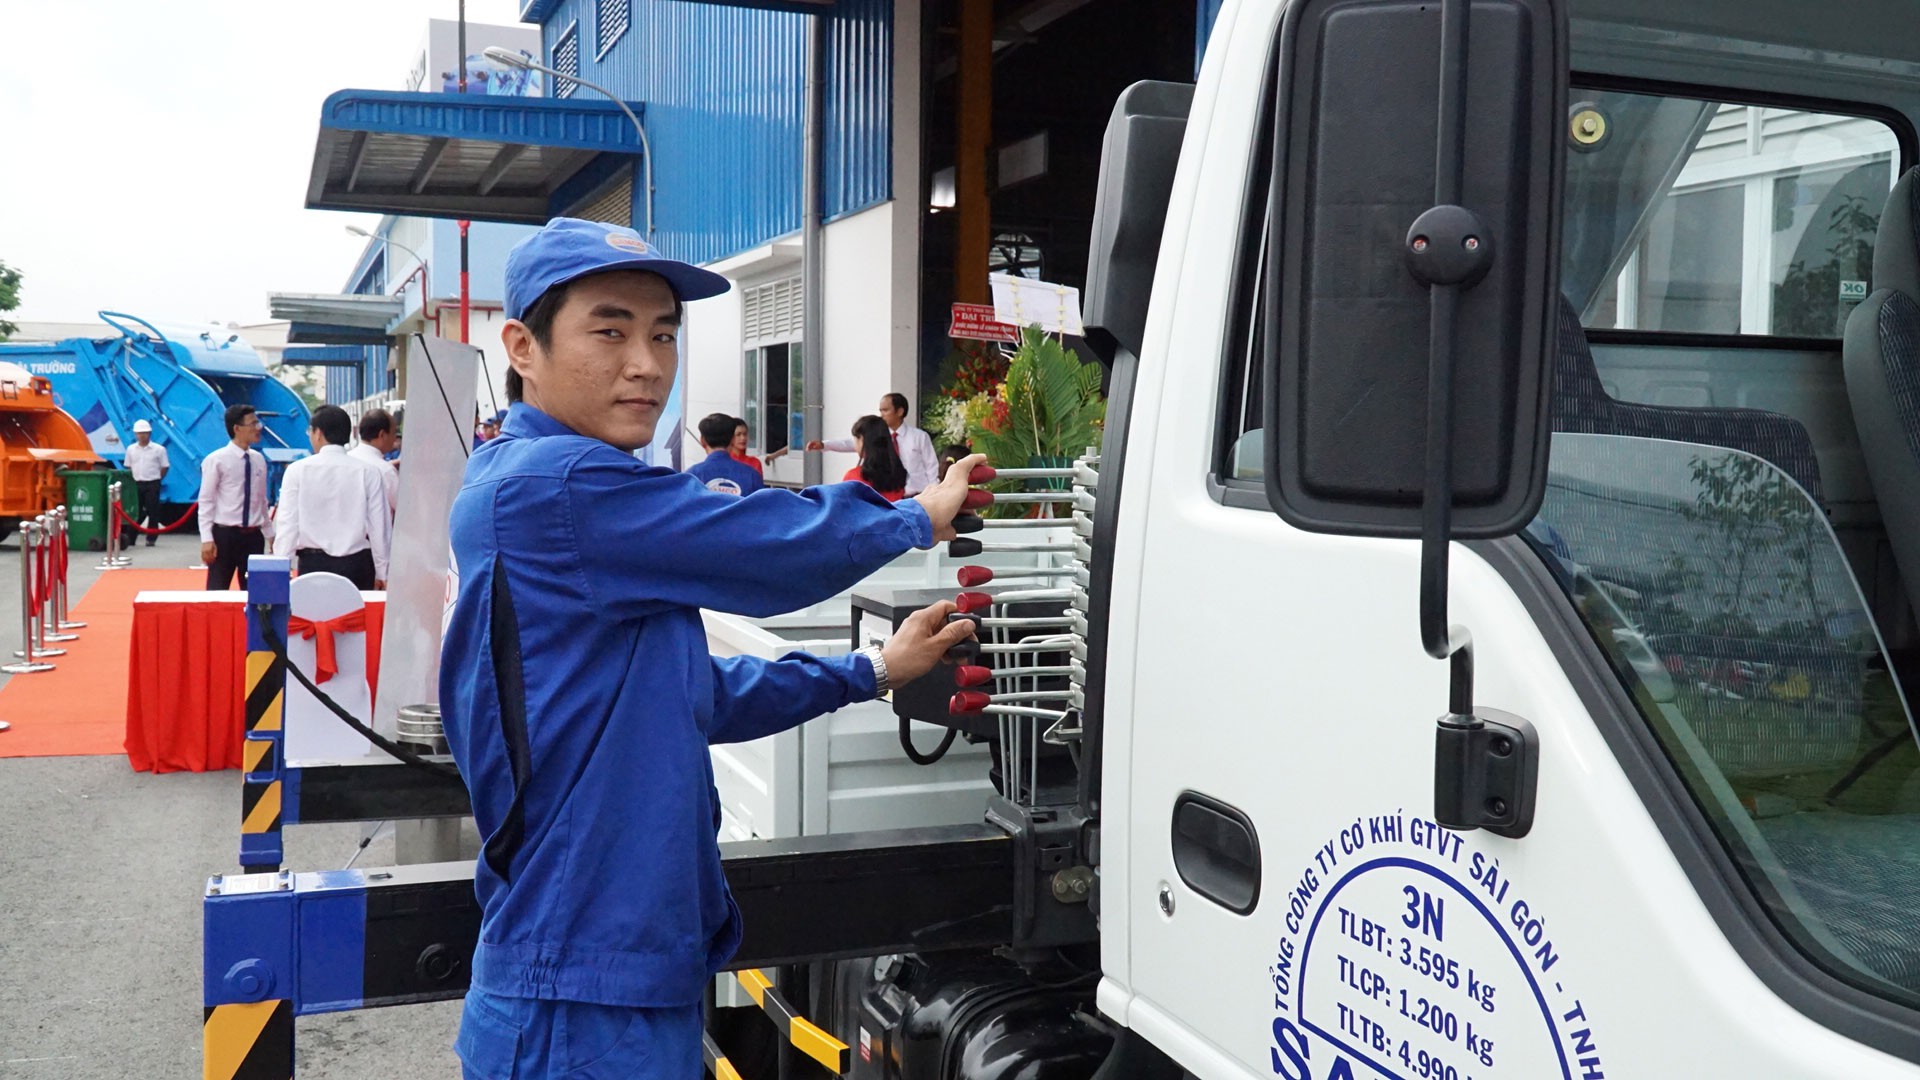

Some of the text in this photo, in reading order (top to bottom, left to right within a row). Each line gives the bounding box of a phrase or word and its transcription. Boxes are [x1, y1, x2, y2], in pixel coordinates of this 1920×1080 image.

[30, 360, 76, 374] TRƯỜNG
[1269, 937, 1295, 1011] TỔNG
[1286, 867, 1320, 935] CÔNG
[1315, 840, 1337, 876] TY
[1369, 808, 1403, 844] KHÍ
[1410, 817, 1465, 864] GTVT
[1468, 851, 1510, 905] SÀI
[1510, 899, 1559, 972] GÒN
[1401, 885, 1444, 942] 3N
[1338, 906, 1496, 1013] TLBT: 3.595 kg
[1336, 1002, 1391, 1057] TLTB:
[1337, 954, 1494, 1067] TLCP: 1.200 kg
